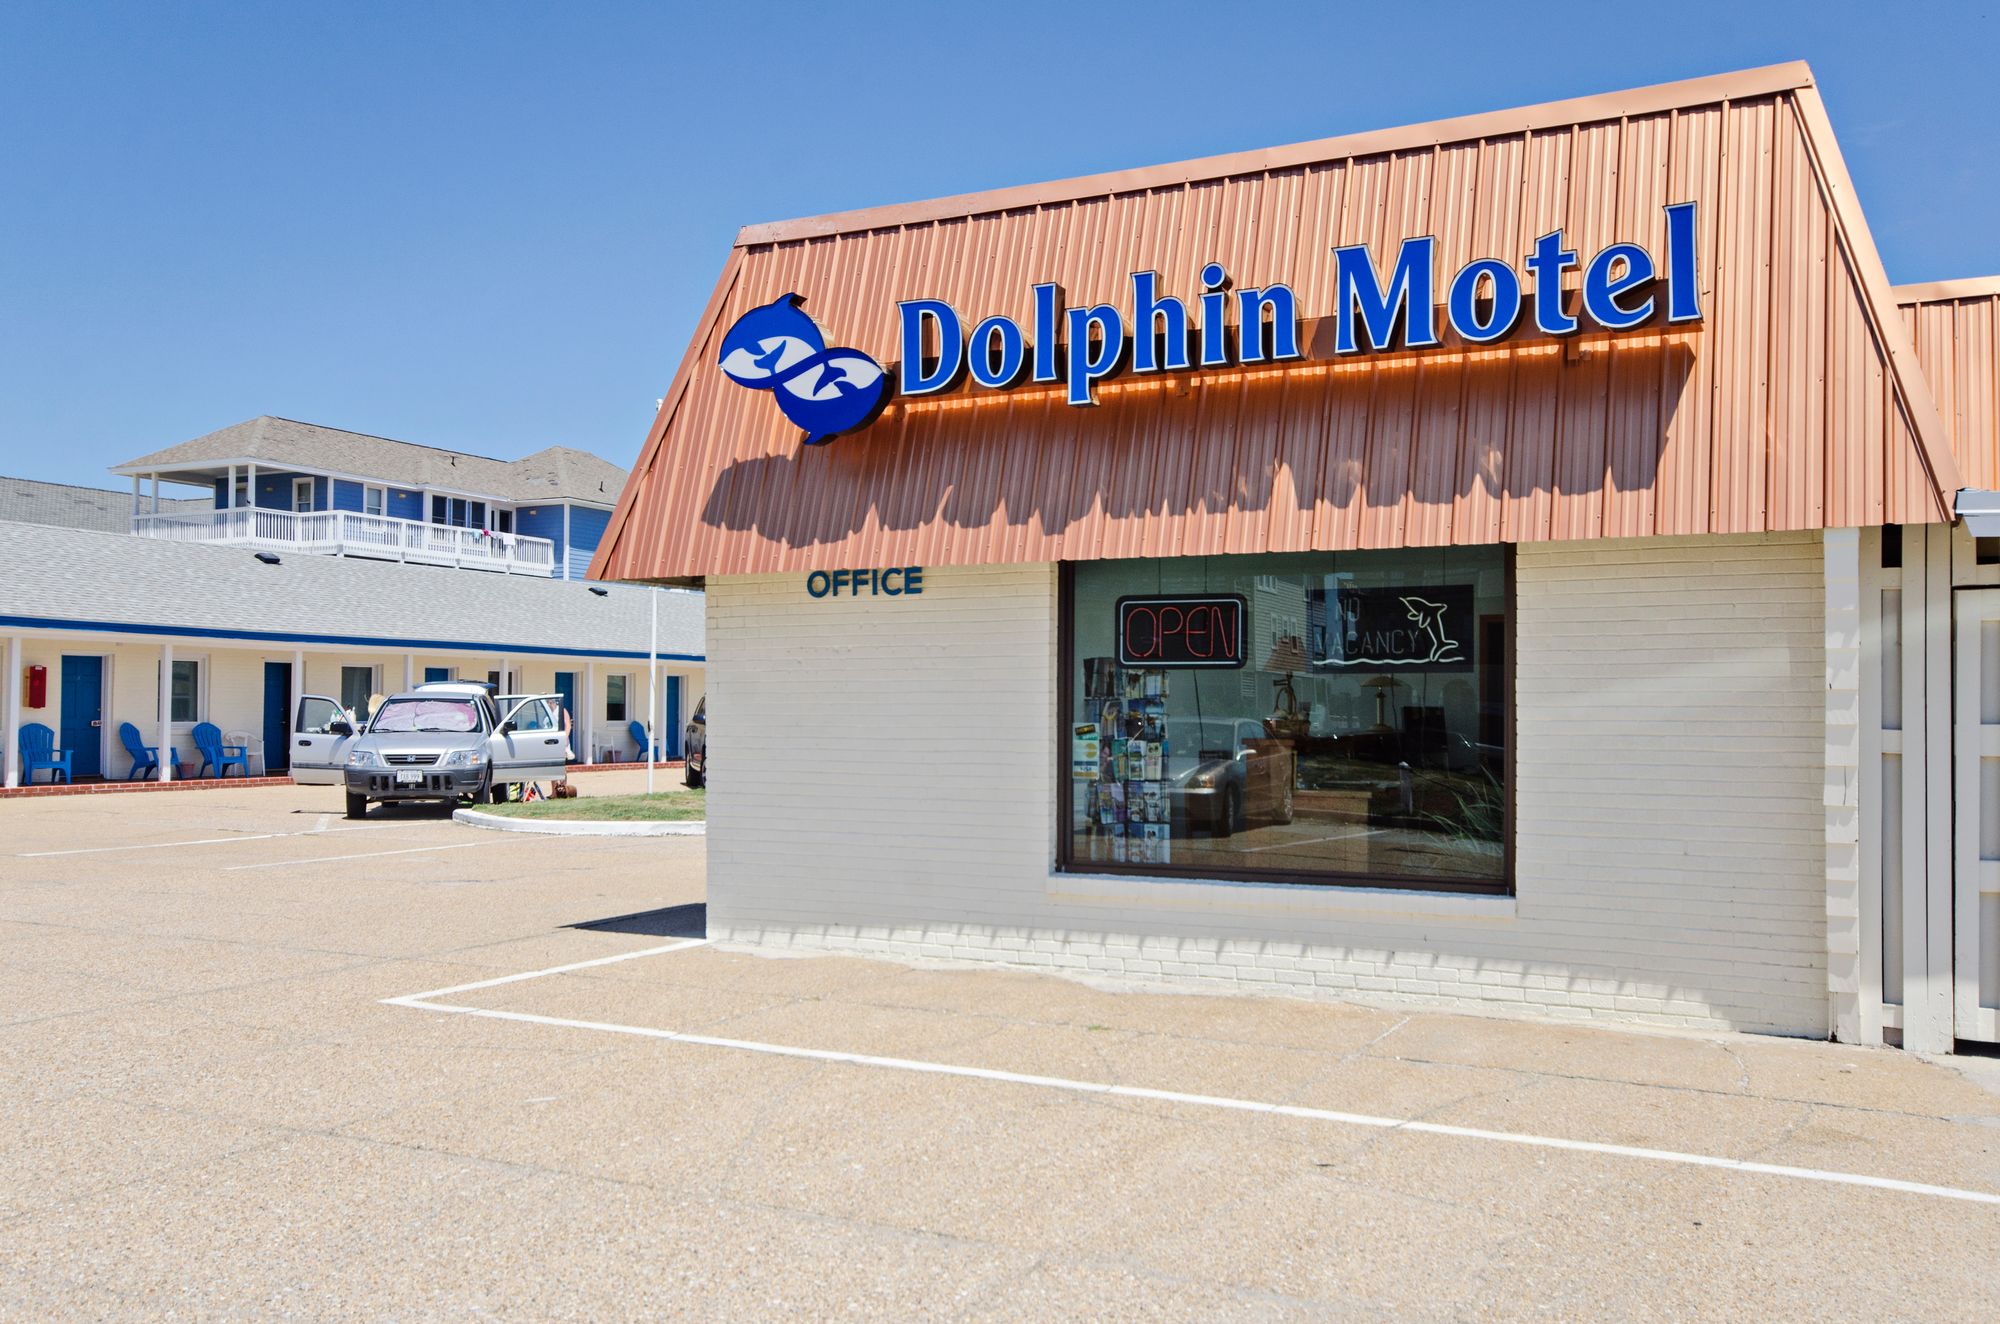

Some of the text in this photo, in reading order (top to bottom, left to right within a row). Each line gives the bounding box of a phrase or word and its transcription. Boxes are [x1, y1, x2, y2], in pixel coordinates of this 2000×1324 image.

[896, 201, 1703, 405] Dolphin Motel
[807, 566, 923, 598] OFFICE
[1335, 597, 1361, 622] NO
[1126, 606, 1236, 657] OPEN
[1314, 629, 1420, 655] VACANCY
